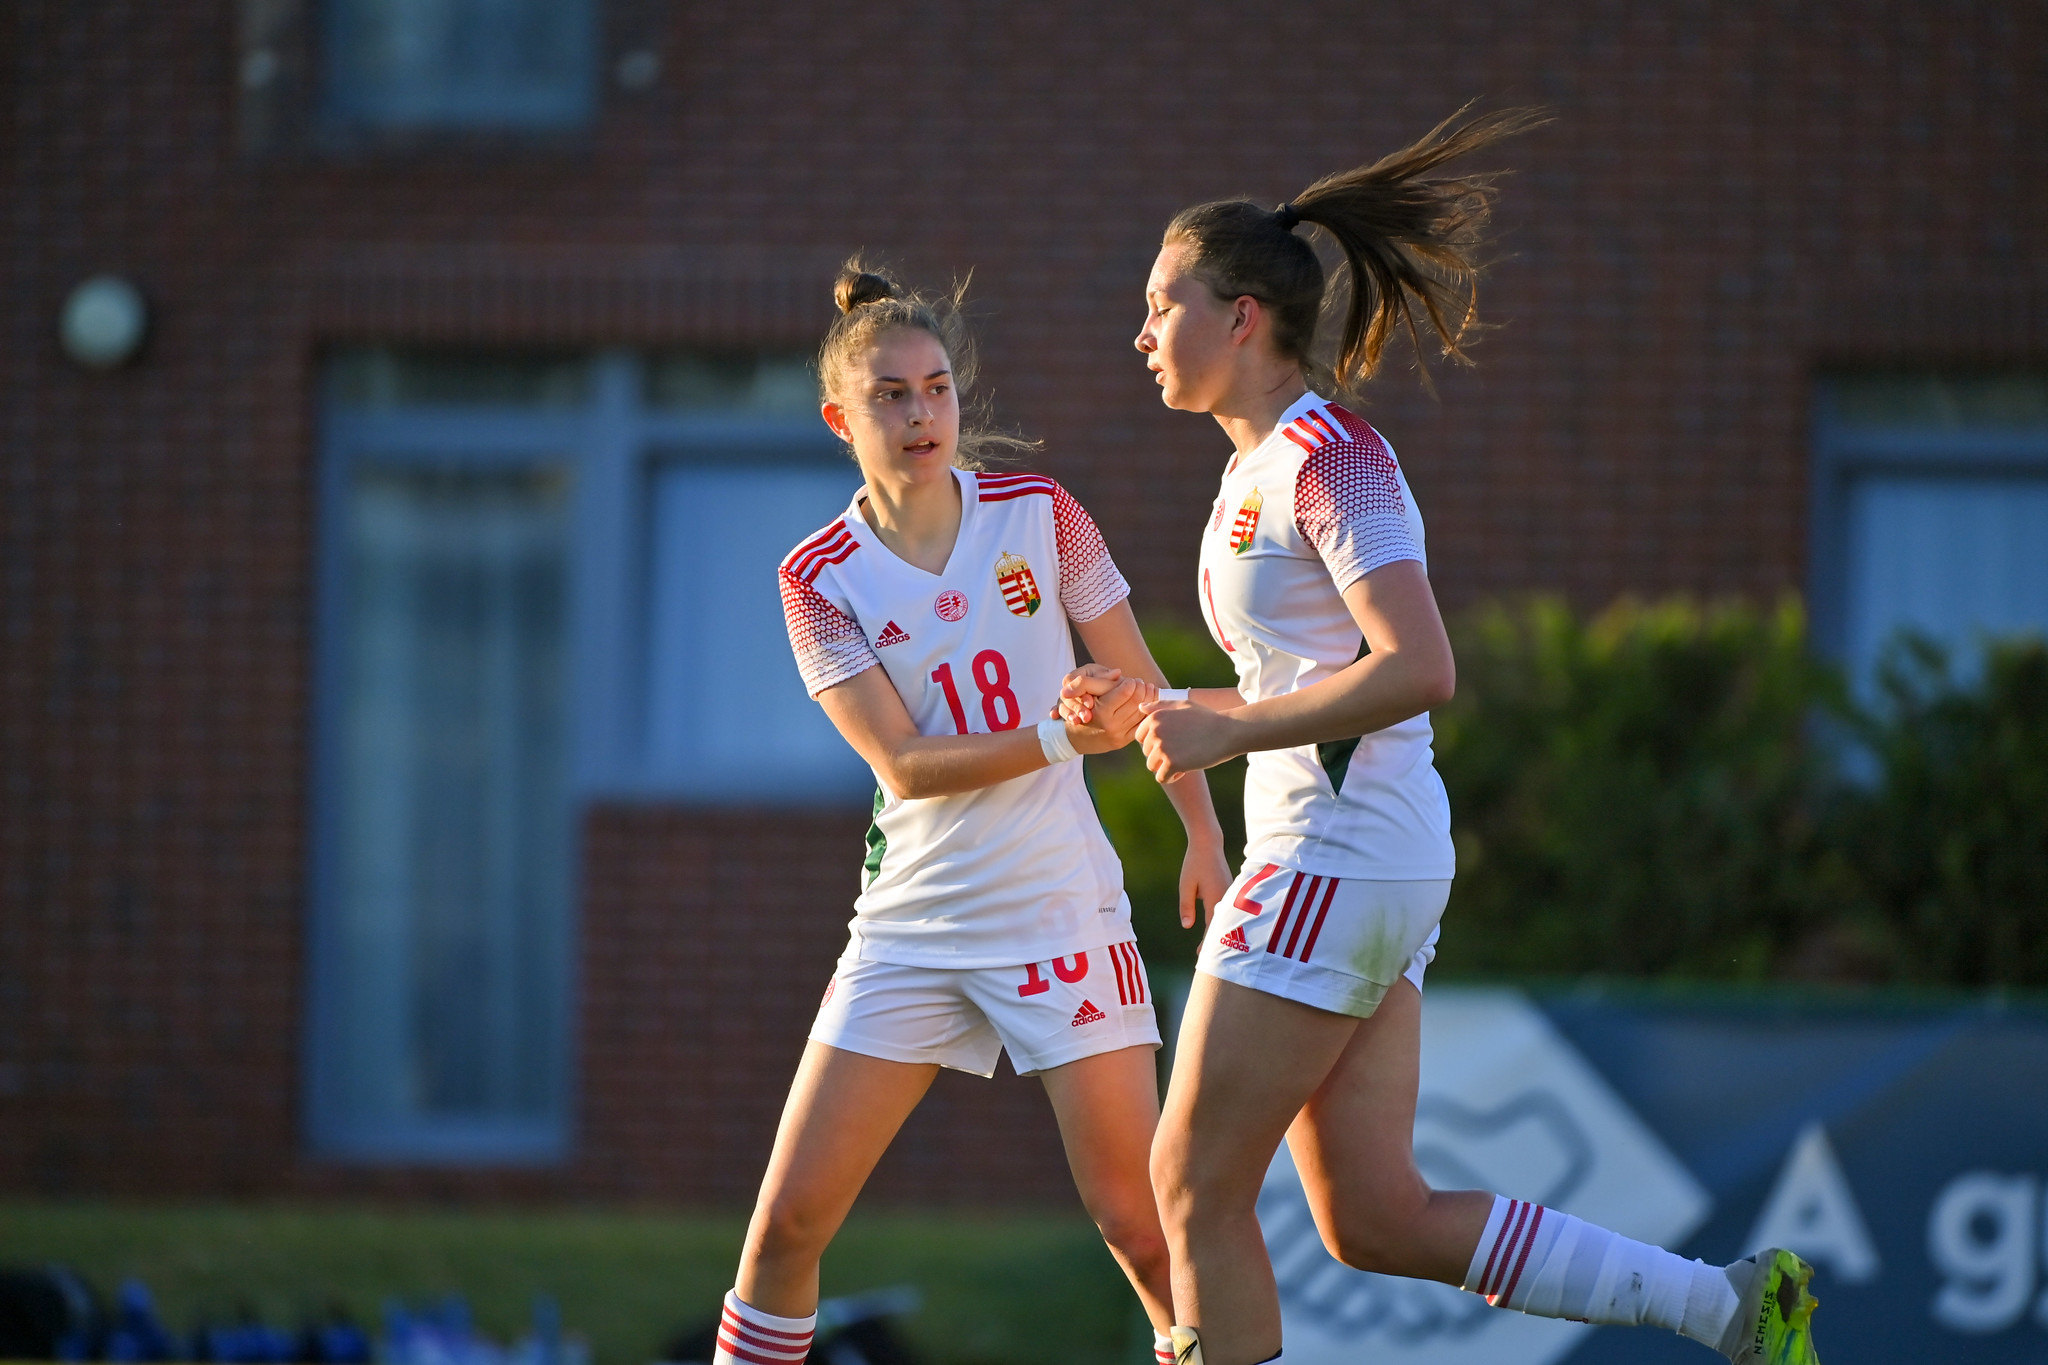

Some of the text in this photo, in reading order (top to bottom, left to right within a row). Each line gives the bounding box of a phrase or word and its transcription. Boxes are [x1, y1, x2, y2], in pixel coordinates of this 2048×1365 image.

[874, 633, 910, 648] adidas
[931, 649, 1021, 735] 18
[1220, 937, 1250, 953] adidas
[1071, 1011, 1106, 1027] adidas
[1742, 1123, 2048, 1332] A g
